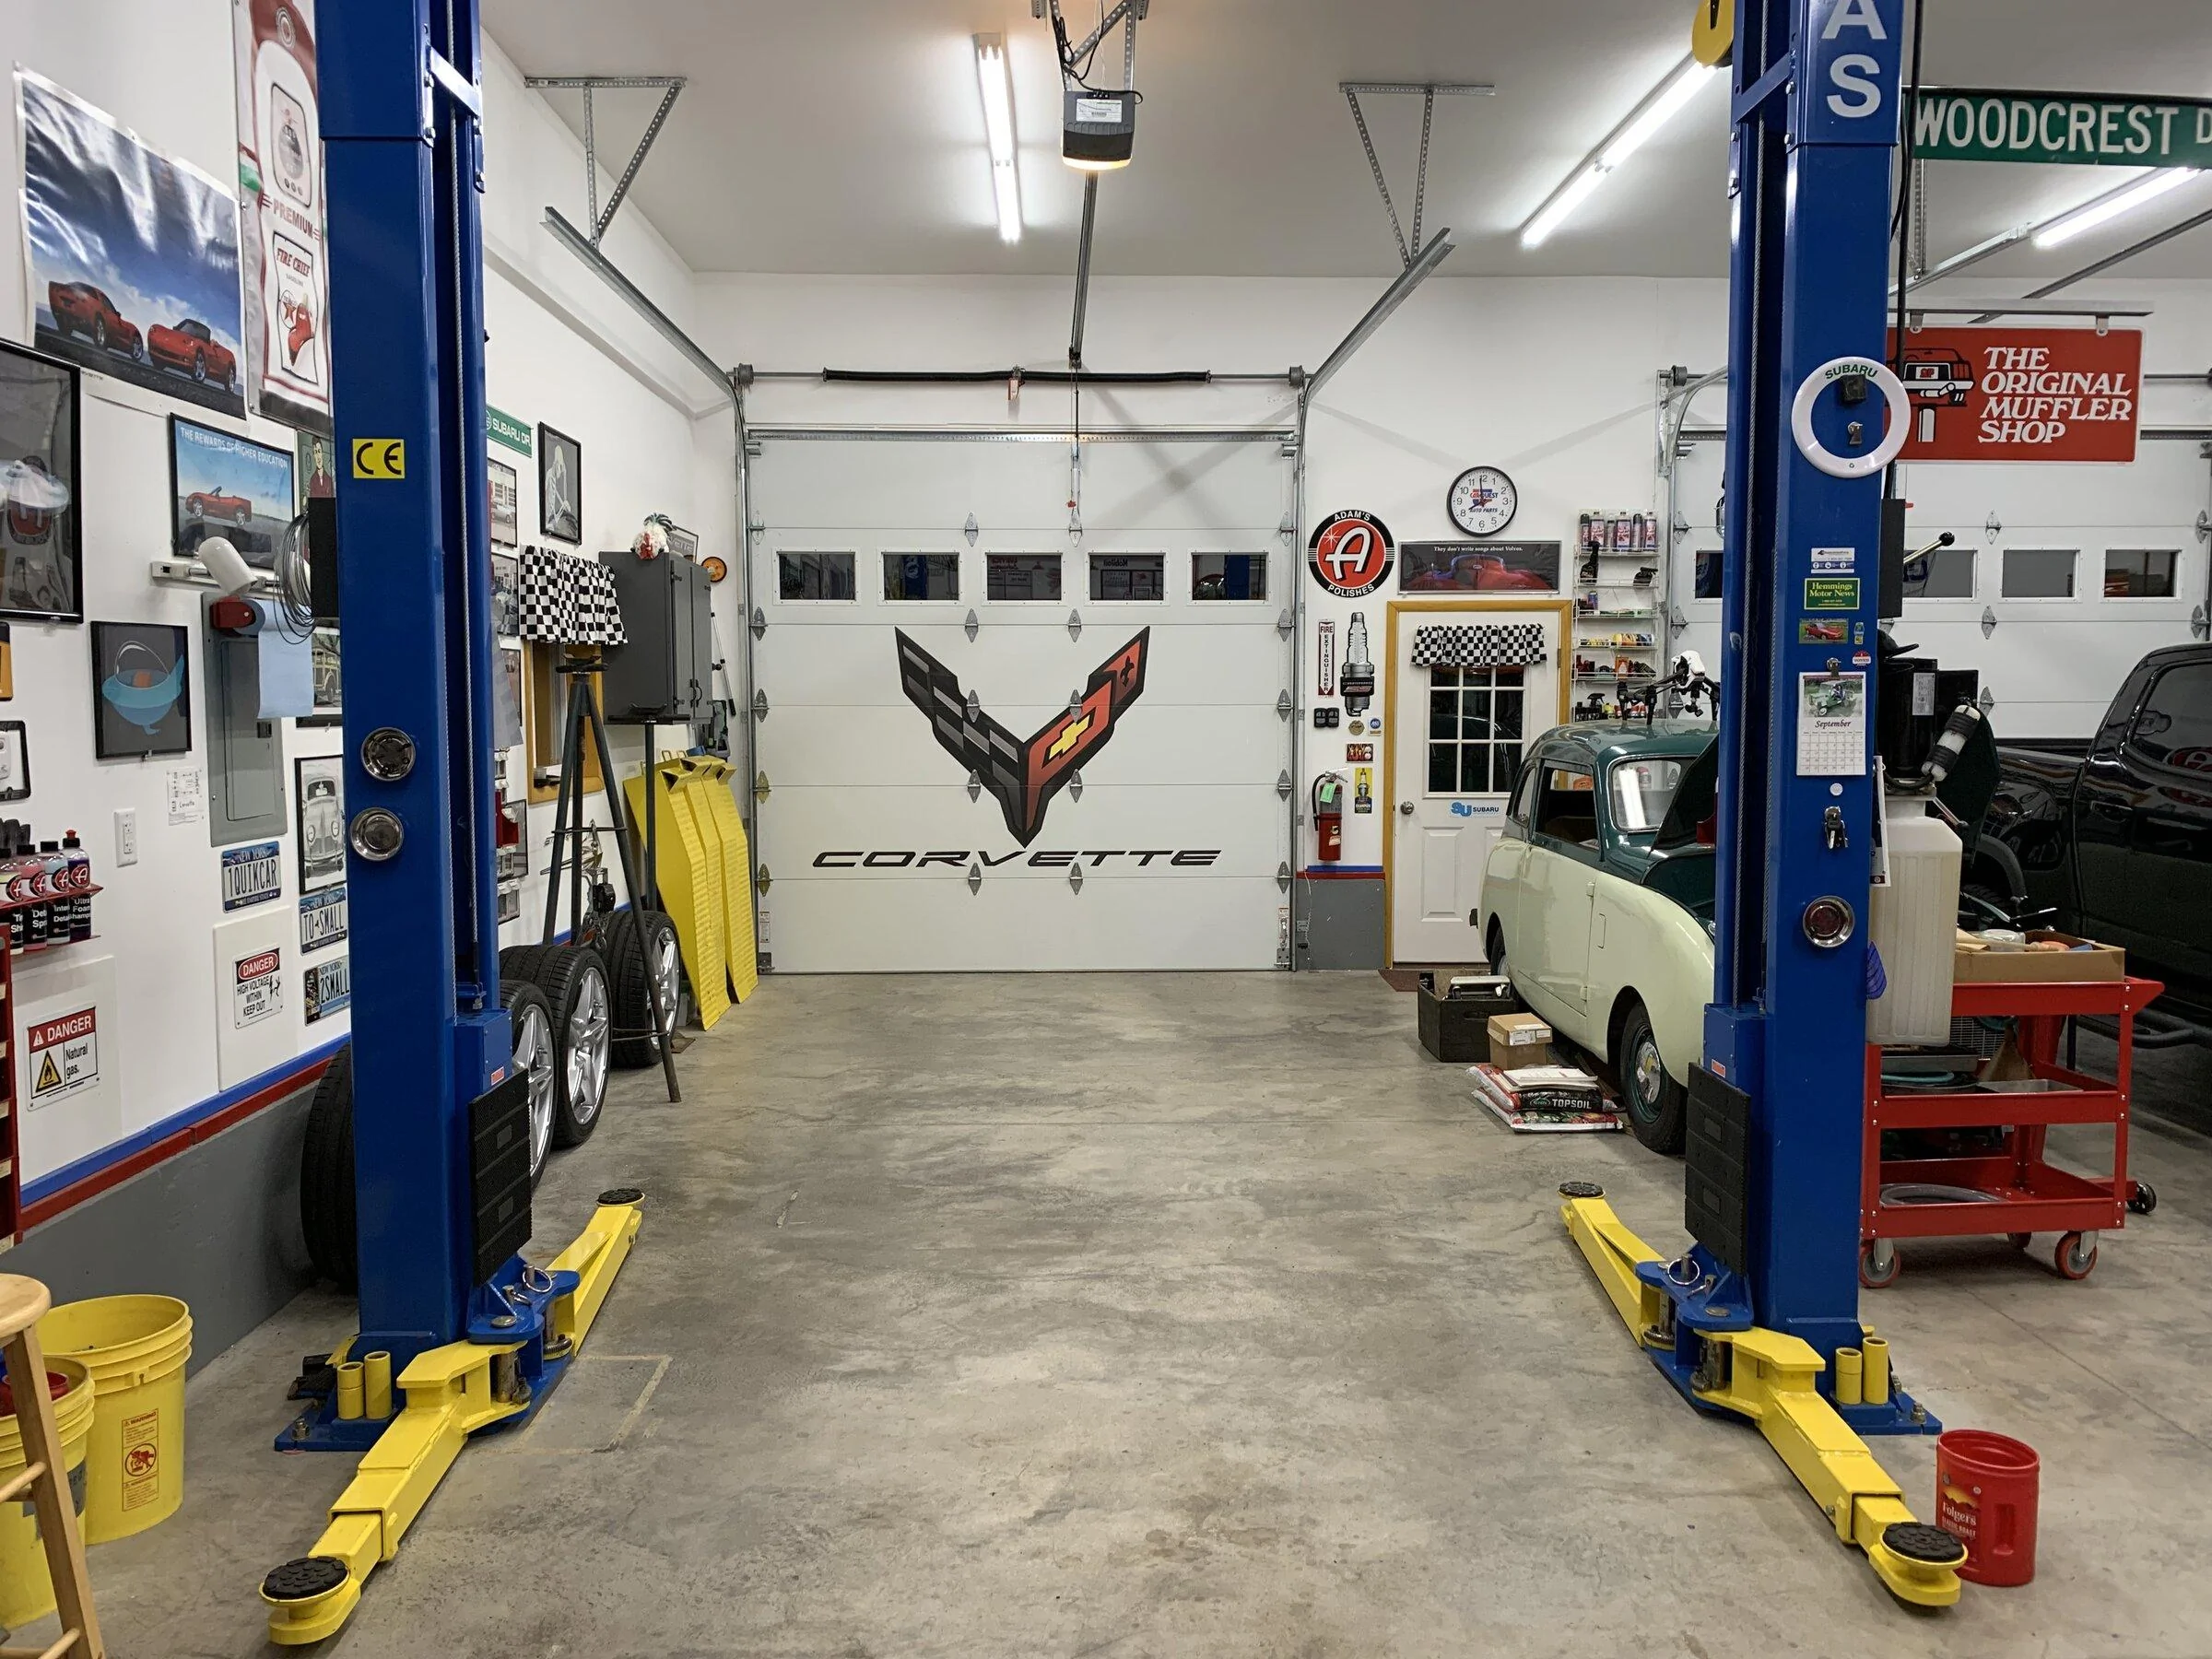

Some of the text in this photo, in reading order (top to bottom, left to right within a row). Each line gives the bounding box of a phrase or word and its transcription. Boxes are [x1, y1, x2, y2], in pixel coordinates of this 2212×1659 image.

[1915, 98, 2180, 156] WOODCREST
[274, 198, 313, 239] PREMIUM
[276, 247, 311, 276] FIRE CHIEF
[1983, 347, 2050, 371] THE
[1824, 364, 1878, 379] SUBARU
[1982, 371, 2132, 396] ORIGINAL
[1980, 396, 2132, 421] MUFFLER
[492, 418, 521, 441] SUBARU
[1977, 419, 2066, 443] SHOP
[181, 427, 193, 441] THE
[194, 430, 226, 449] REWARDS
[257, 451, 288, 468] EDUCATION
[356, 441, 402, 475] CE
[1460, 487, 1469, 495] 10
[1500, 487, 1507, 495] 2
[1334, 511, 1371, 521] ADAM'S
[1460, 509, 1466, 517] 8
[1478, 520, 1485, 528] 6
[1324, 526, 1371, 580] A
[1327, 583, 1374, 597] POLISHES
[1812, 582, 1853, 592] Hemmings
[1815, 719, 1851, 729] September
[813, 849, 1222, 868] CORVETTE
[229, 859, 277, 897] 1QUIKCAR
[242, 956, 274, 977] DANGER
[237, 975, 269, 995] HIGH VOLTAGE
[320, 968, 349, 1005] 2SMALL
[246, 989, 262, 1004] WITHIN
[243, 1000, 265, 1017] KEEP OUT
[47, 1015, 91, 1042] DANGER
[65, 1042, 88, 1061] Natural
[66, 1064, 79, 1079] gas.
[1552, 1099, 1592, 1110] TOPSOIL
[1942, 1501, 1977, 1526] Folgers
